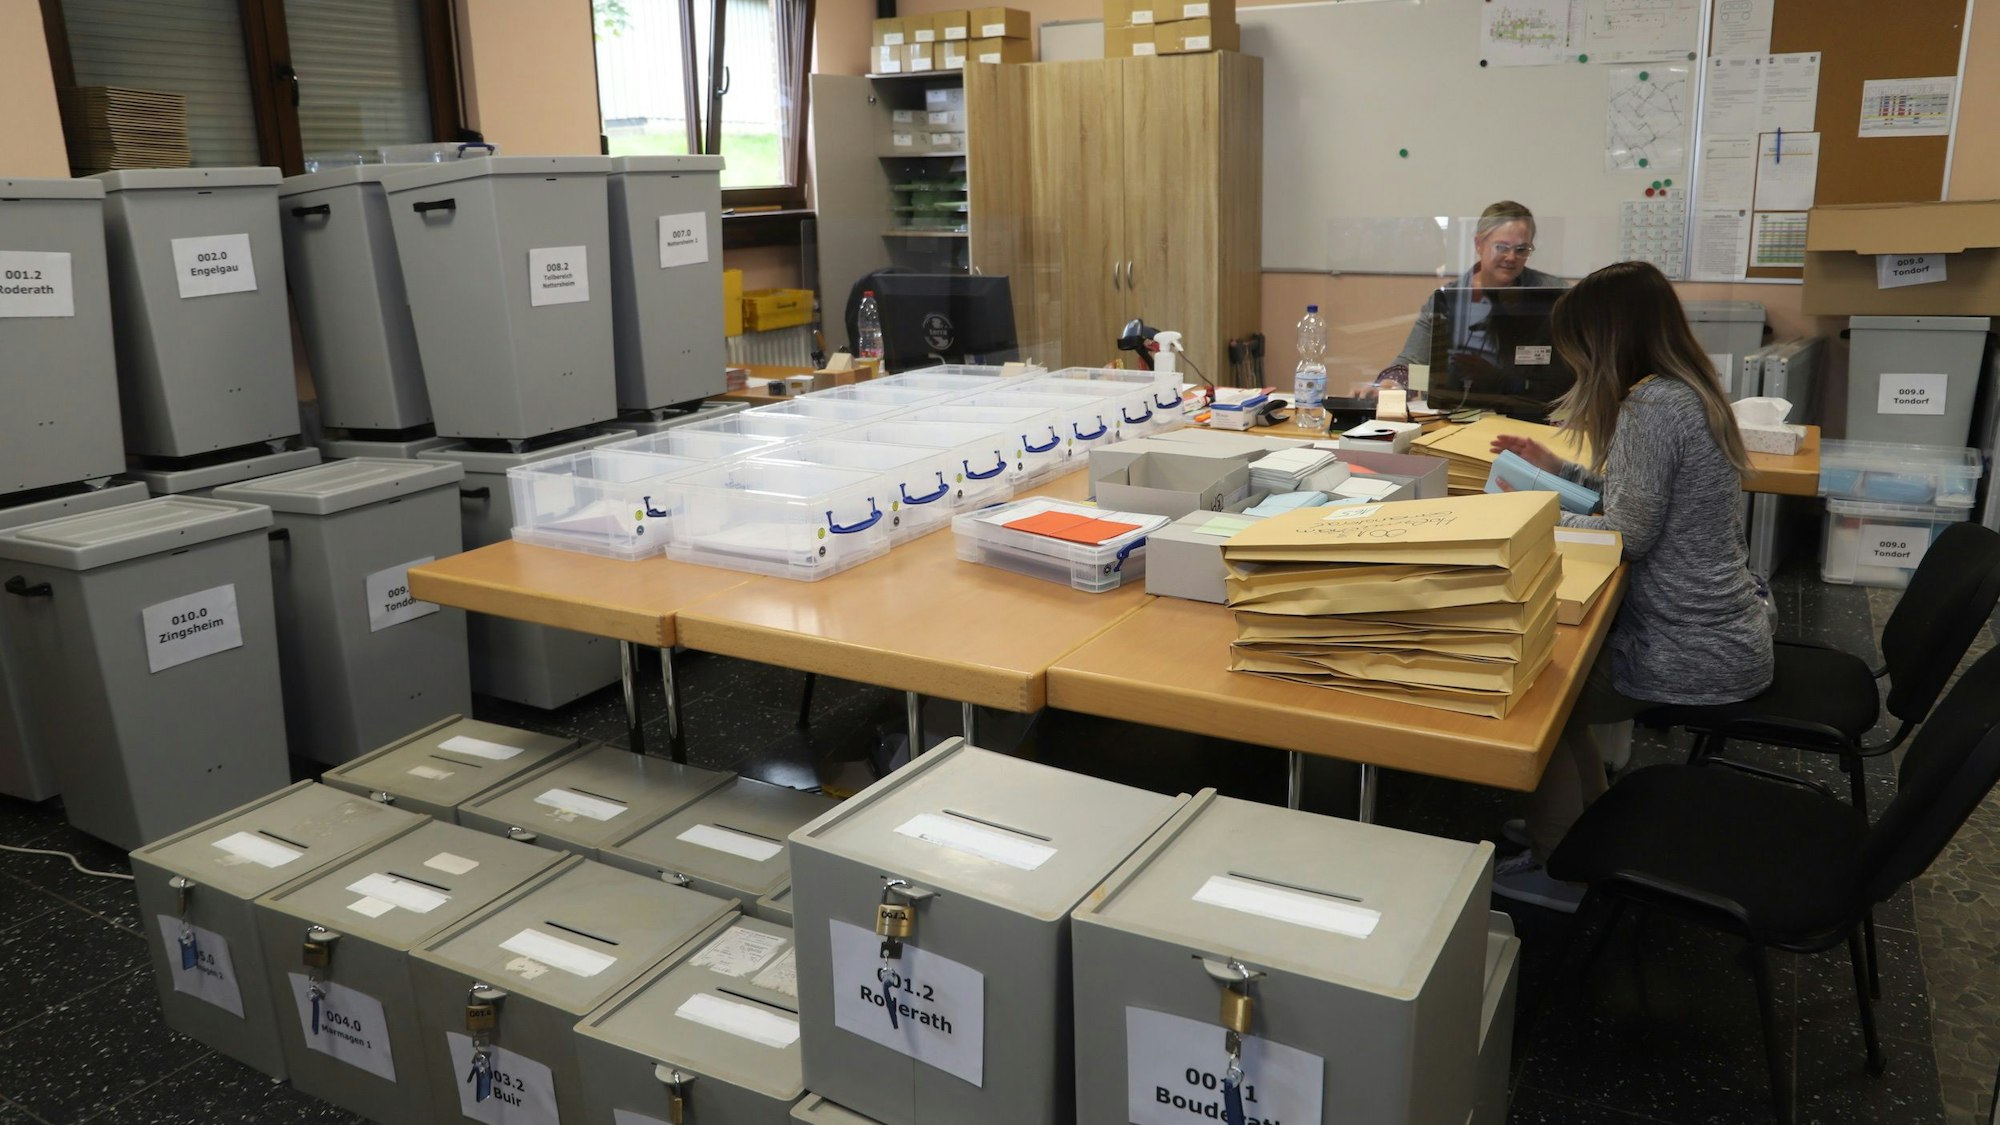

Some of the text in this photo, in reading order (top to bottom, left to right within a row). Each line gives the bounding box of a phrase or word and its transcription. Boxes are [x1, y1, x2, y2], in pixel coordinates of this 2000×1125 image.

[672, 229, 692, 239] 007.0
[197, 251, 228, 262] 002.0
[1897, 257, 1924, 267] 009.0
[190, 264, 239, 278] Engelgau
[546, 262, 569, 272] 008.2
[1892, 265, 1931, 277] Tondorf
[5, 270, 42, 280] 001.2
[1898, 388, 1925, 396] 009.0
[1879, 541, 1906, 549] 009.0
[1874, 550, 1911, 558] Tondorf
[388, 586, 409, 598] 009.
[171, 608, 208, 626] 010.0
[158, 618, 224, 644] Zingsheim
[326, 1010, 362, 1032] 004.0
[366, 1040, 373, 1049] 1
[491, 1070, 525, 1092] 03.2
[493, 1086, 523, 1108] Buir
